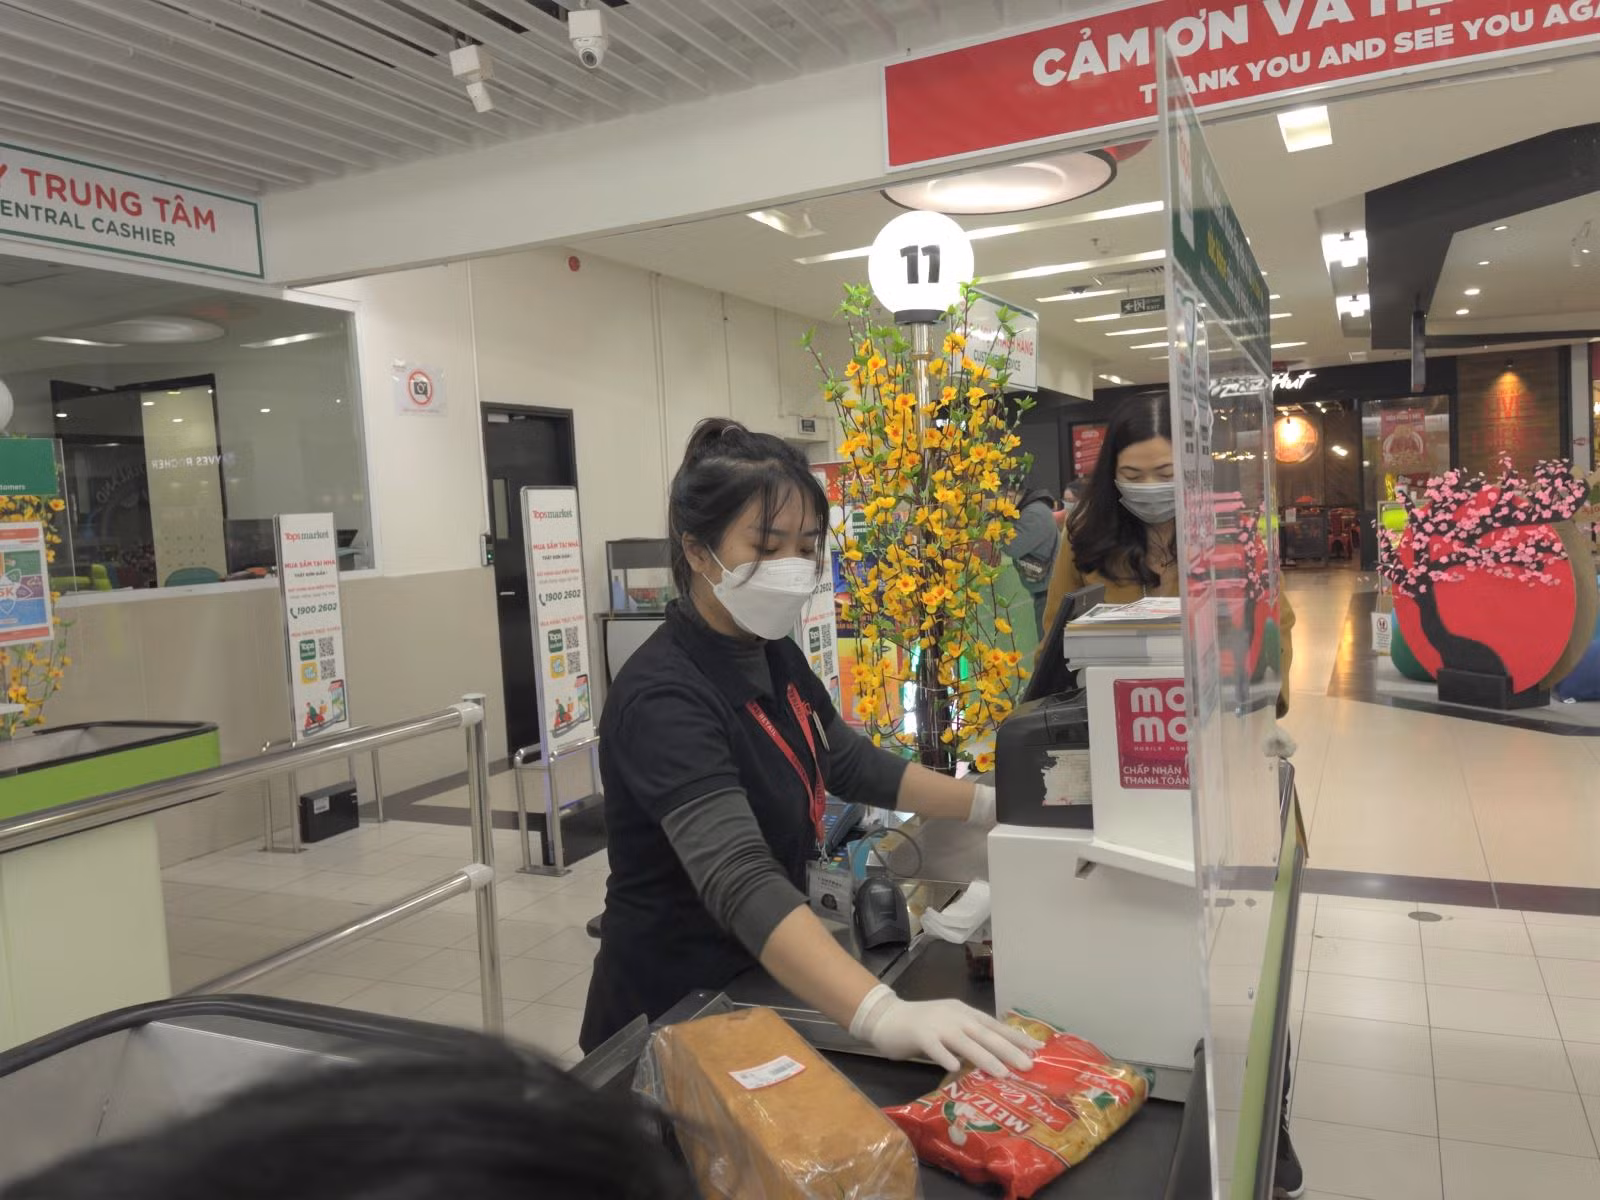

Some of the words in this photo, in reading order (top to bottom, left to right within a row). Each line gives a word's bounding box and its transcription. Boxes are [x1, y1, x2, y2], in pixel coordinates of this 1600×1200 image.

[1032, 27, 1150, 87] CẢM
[1166, 5, 1249, 58] ƠN
[1139, 65, 1240, 104] TANK
[1246, 50, 1311, 82] YOU
[1318, 37, 1387, 69] AND
[1393, 23, 1455, 53] SEE
[1461, 9, 1535, 41] YOU
[20, 167, 143, 217] TRUNG
[152, 194, 216, 233] TÂM
[91, 217, 176, 247] CASHIER
[900, 245, 941, 284] 11
[1272, 371, 1317, 391] Hut
[297, 605, 317, 615] 1900
[318, 602, 338, 612] 2602
[545, 592, 563, 602] 1900
[564, 589, 581, 599] 2602
[1130, 686, 1185, 713] mo
[1132, 716, 1190, 743] mo
[1122, 764, 1150, 775] CHẤP
[1152, 764, 1182, 776] NHẬN
[1123, 776, 1159, 785] THANH
[1161, 773, 1190, 785] TOÁN
[941, 1081, 1031, 1133] MEIZAN
